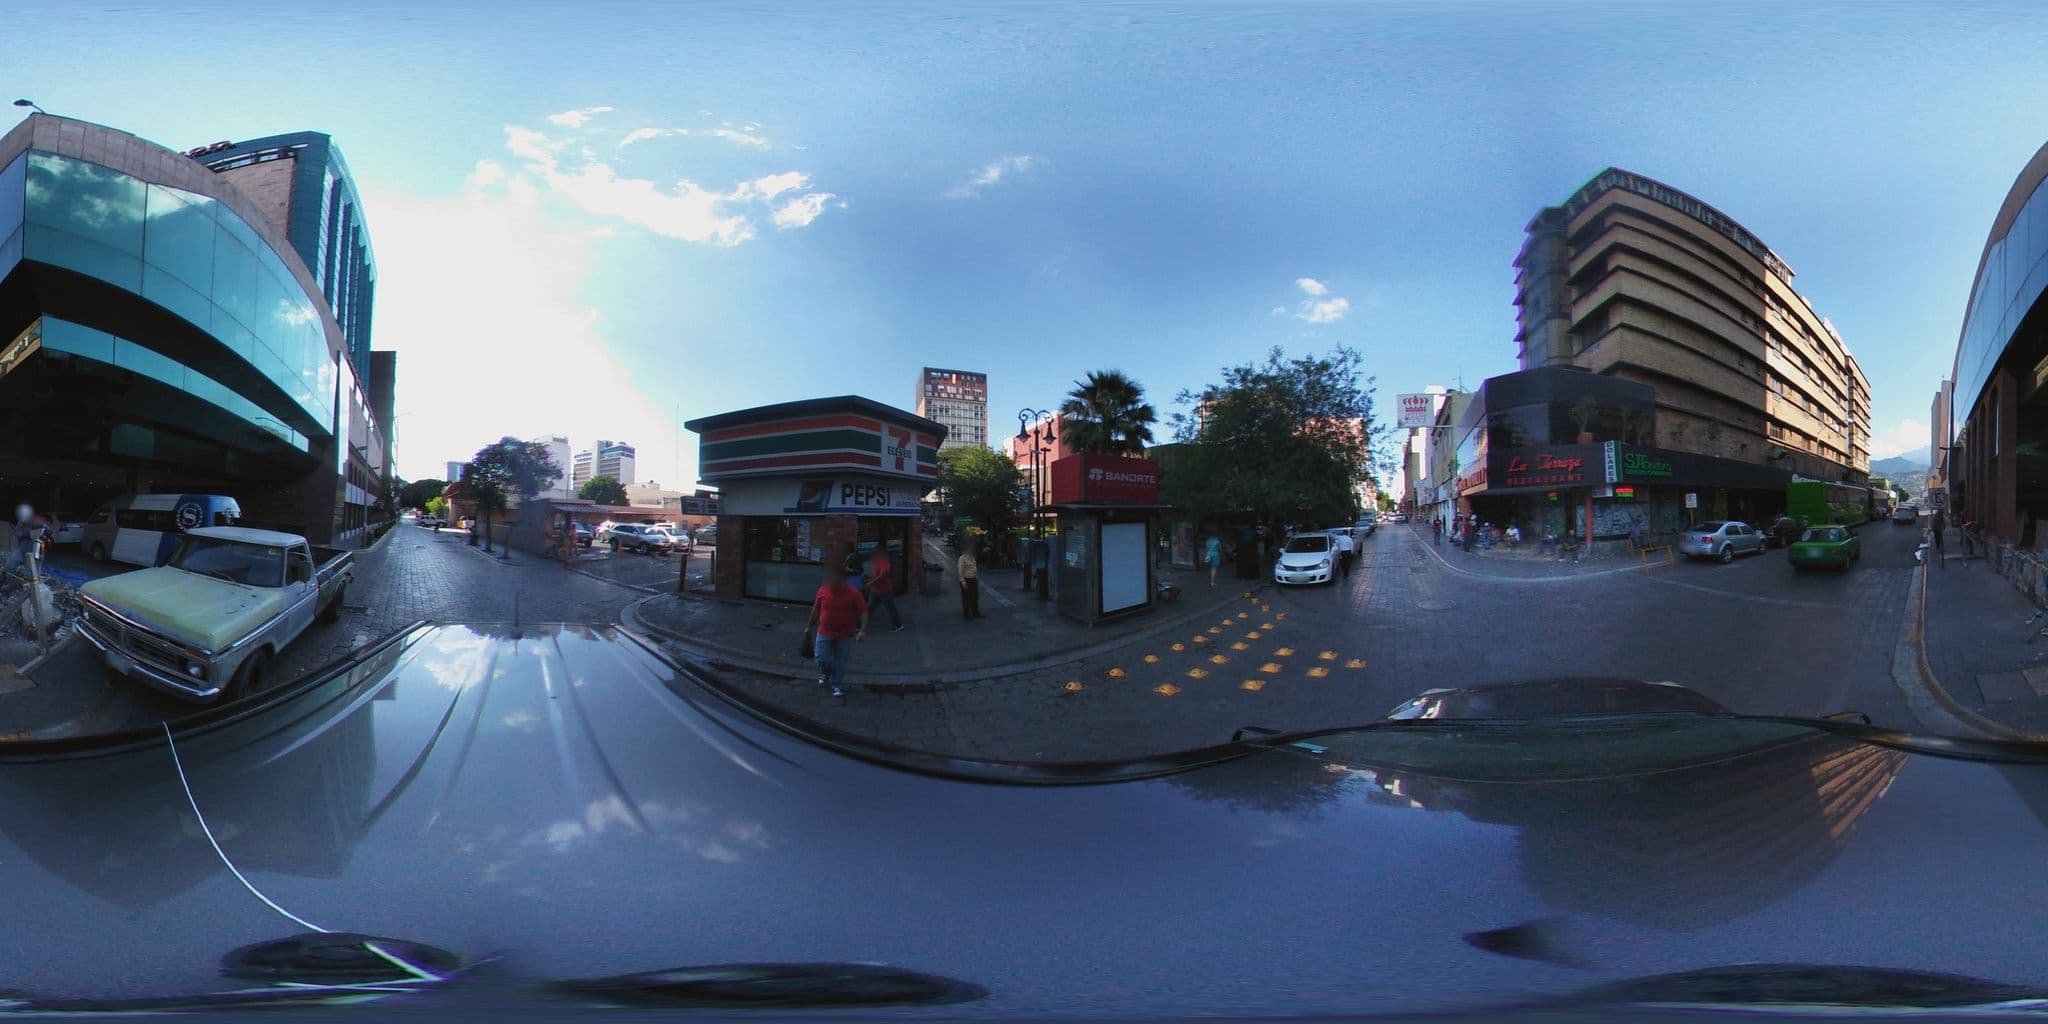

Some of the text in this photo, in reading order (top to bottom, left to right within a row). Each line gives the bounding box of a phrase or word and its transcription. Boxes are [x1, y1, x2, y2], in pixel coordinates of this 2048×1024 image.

[1506, 456, 1529, 473] La
[1105, 472, 1156, 484] BANORTE
[841, 483, 890, 507] PEPSI
